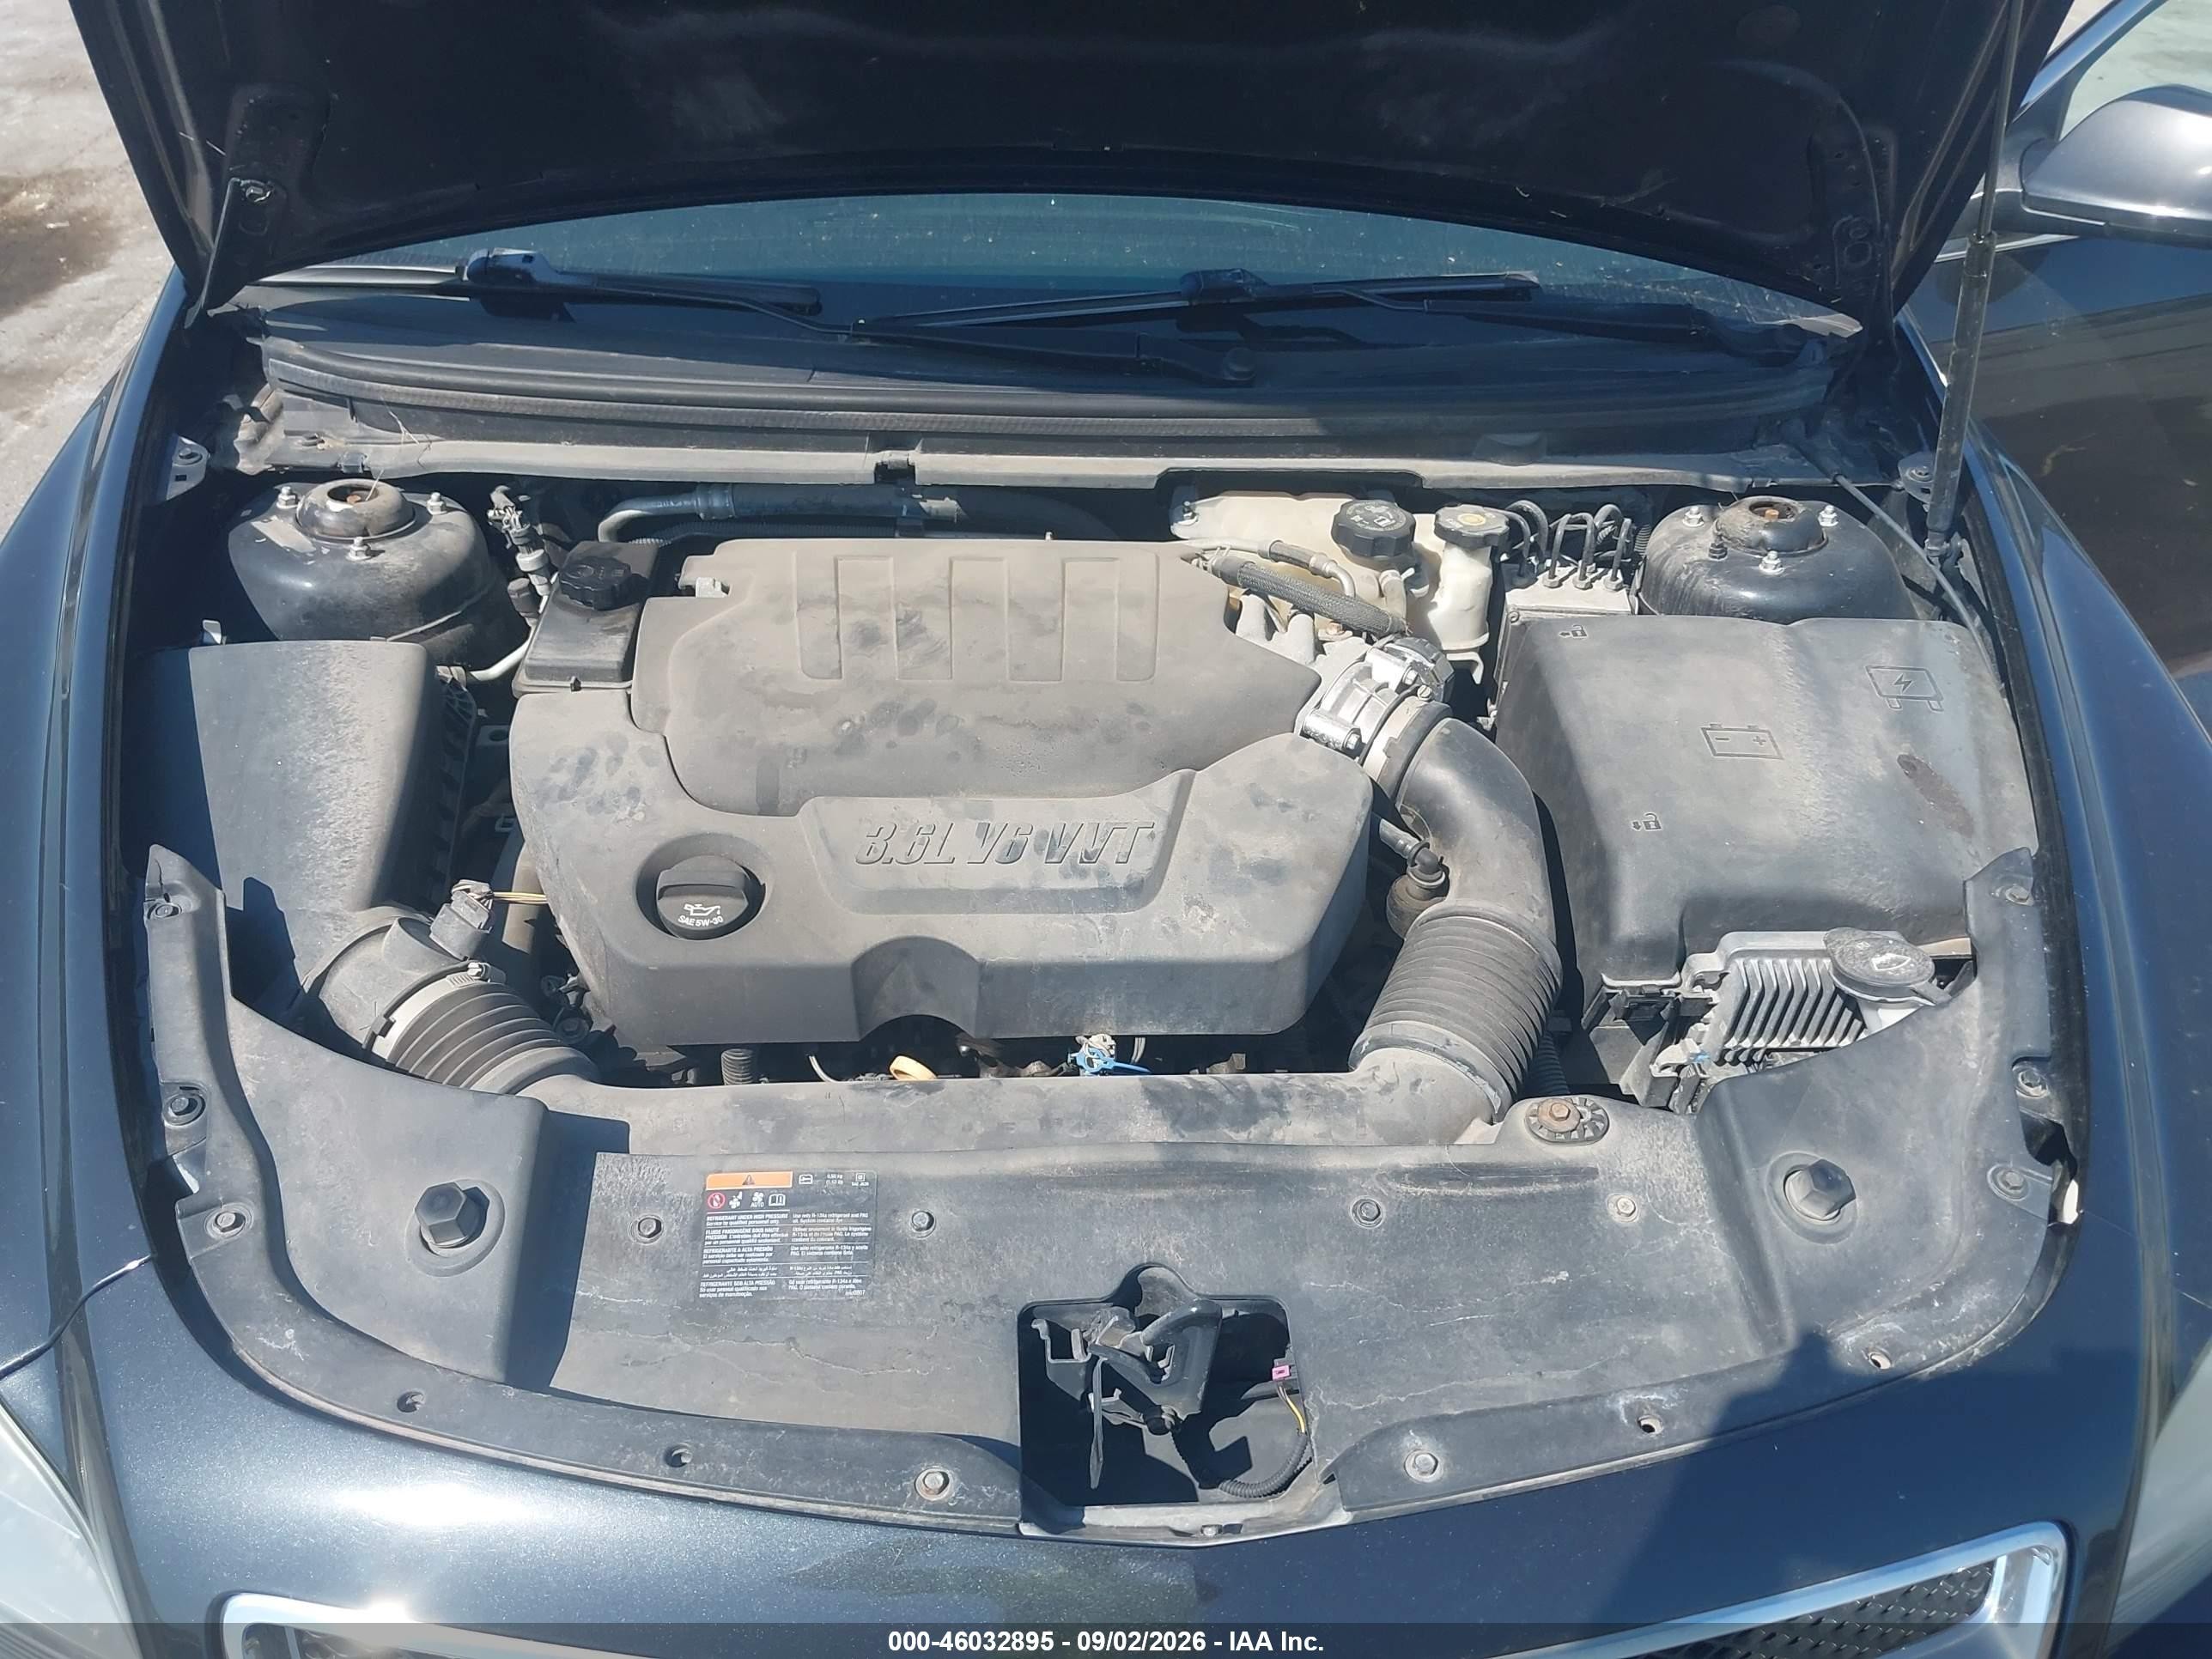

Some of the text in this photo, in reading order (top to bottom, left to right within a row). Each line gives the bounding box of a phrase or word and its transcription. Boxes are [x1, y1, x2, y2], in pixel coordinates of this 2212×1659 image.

[854, 821, 1156, 865] 3.6L V6 VVT
[678, 915, 724, 927] SAE 5W-30
